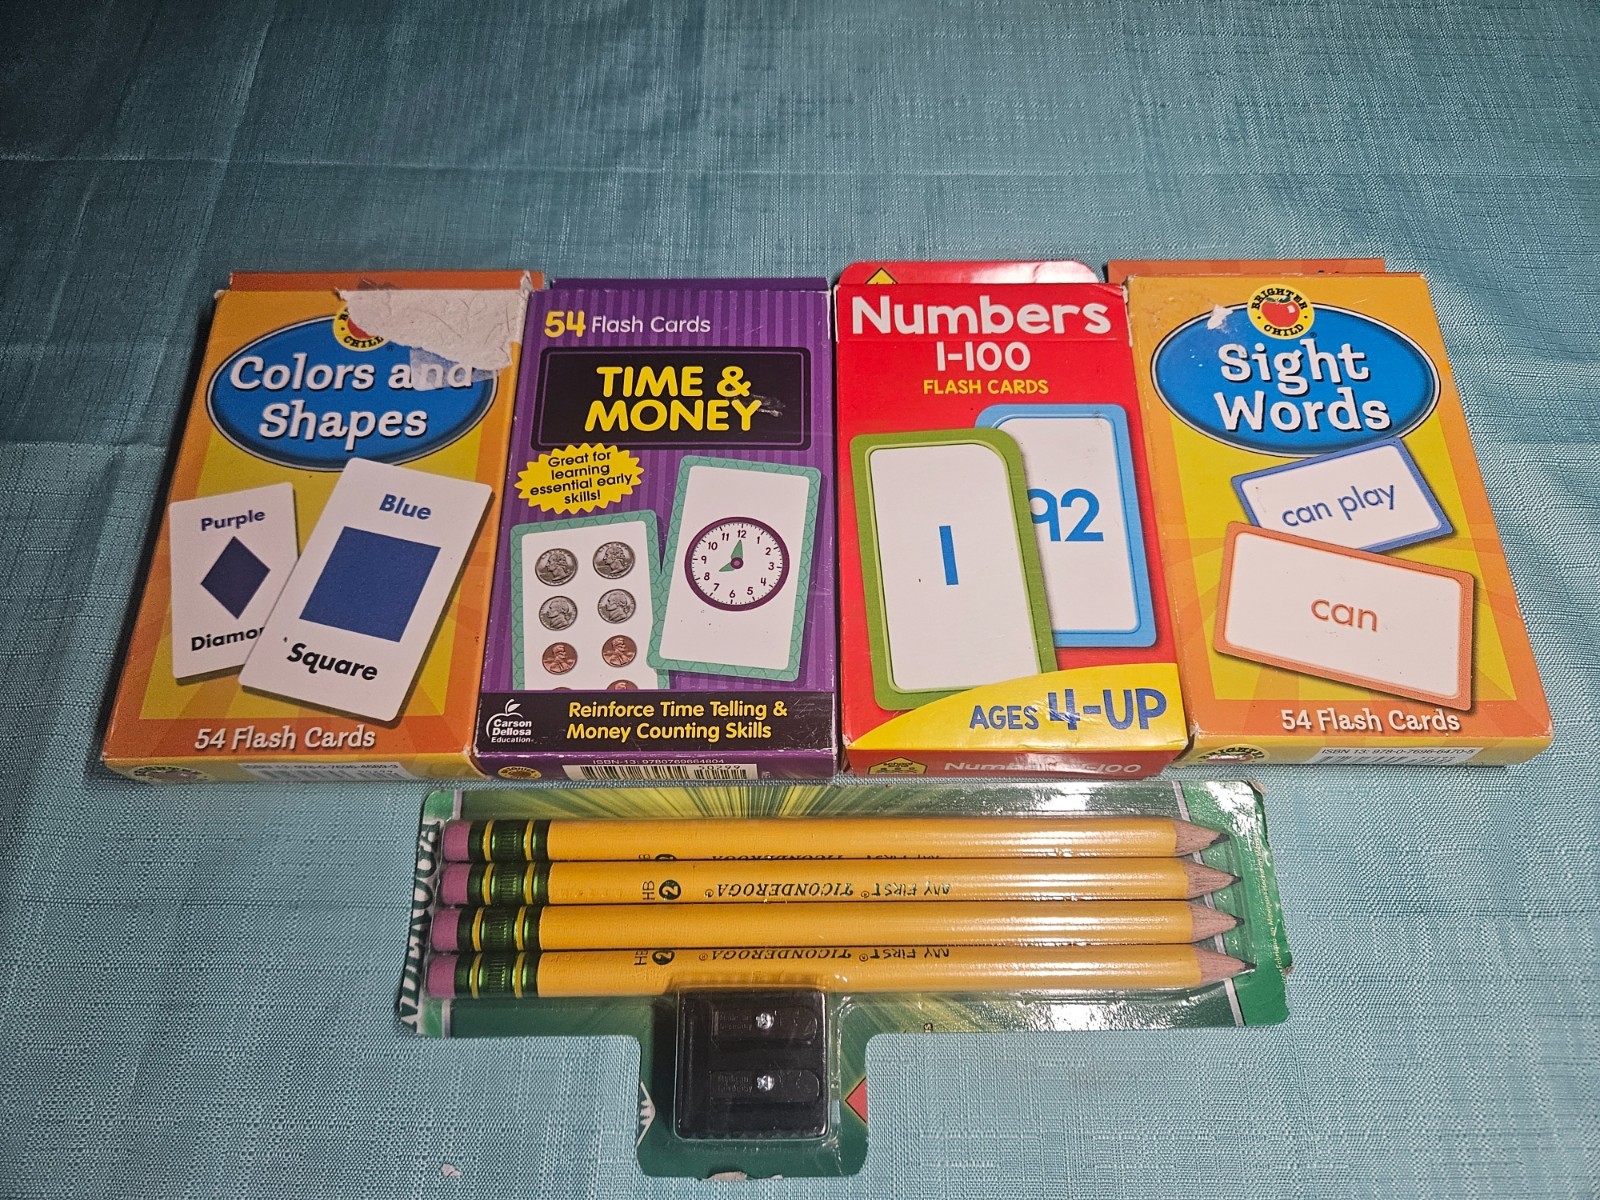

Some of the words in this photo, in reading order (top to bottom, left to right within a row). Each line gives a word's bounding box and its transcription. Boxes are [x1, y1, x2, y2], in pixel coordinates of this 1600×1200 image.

[1251, 288, 1308, 310] BRIGHTER
[544, 310, 586, 338] 54
[591, 315, 643, 334] Flash
[650, 315, 711, 334] Cards
[852, 295, 1112, 335] Numbers
[1263, 324, 1304, 336] CHILD
[936, 341, 1031, 372] 1-100
[230, 352, 375, 391] Colors
[1217, 338, 1369, 396] Sight
[596, 365, 704, 398] TIME
[716, 365, 752, 398] &
[923, 379, 982, 395] FLASH
[987, 378, 1049, 394] CARDS
[584, 400, 762, 431] MONEY
[1214, 387, 1391, 431] Words
[259, 400, 427, 451] Shapes
[548, 453, 589, 467] Great
[593, 451, 611, 462] for
[551, 464, 610, 480] learning
[530, 478, 592, 496] essential
[597, 473, 632, 487] early
[564, 489, 601, 504] skills!
[1281, 501, 1333, 528] can
[1337, 484, 1395, 517] play
[379, 494, 432, 521] Blue
[1028, 488, 1105, 543] 92
[201, 509, 266, 532] Purple
[721, 532, 730, 541] 11
[737, 530, 747, 538] 12
[756, 536, 761, 544] 1
[708, 542, 718, 550] 10
[765, 547, 771, 556] 2
[701, 556, 707, 564] 9
[768, 562, 774, 570] 3
[704, 572, 710, 580] 8
[760, 577, 767, 586] 4
[714, 583, 720, 591] 7
[729, 589, 736, 598] 6
[746, 587, 754, 595] 5
[1311, 598, 1379, 632] can
[287, 642, 379, 682] Square
[568, 701, 655, 718] Reinforce
[659, 701, 705, 717] Time
[710, 701, 767, 721] Telling
[773, 701, 788, 717] &
[968, 704, 1039, 730] AGES
[1281, 709, 1312, 731] 54
[1318, 707, 1382, 732] Flash
[1388, 709, 1461, 731] Cards
[492, 728, 532, 736] Dellosa
[493, 719, 532, 728] Carson
[566, 723, 630, 743] Money
[636, 722, 720, 743] Counting
[725, 722, 772, 739] Skills
[194, 728, 225, 750] 54
[232, 725, 296, 751] Flash
[304, 725, 376, 750] Cards
[642, 880, 655, 900] HB
[924, 881, 951, 896] MY
